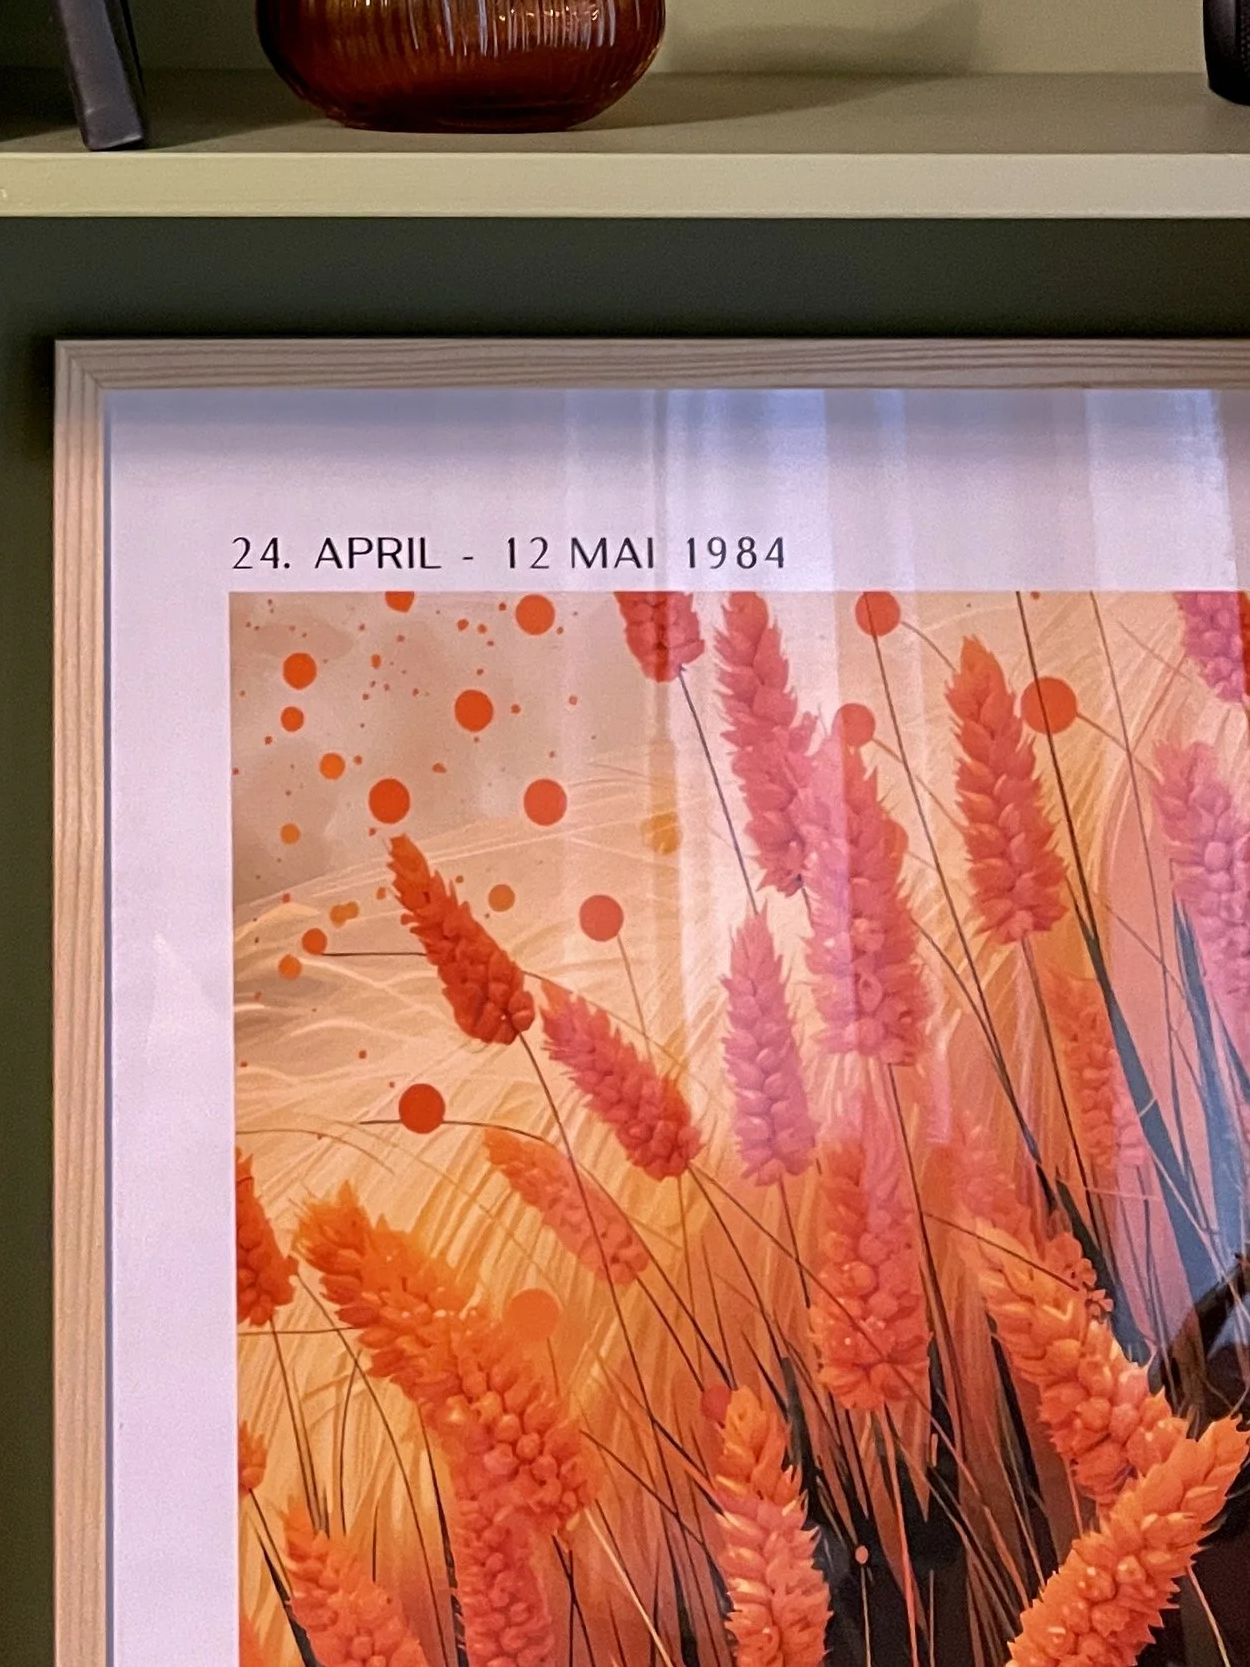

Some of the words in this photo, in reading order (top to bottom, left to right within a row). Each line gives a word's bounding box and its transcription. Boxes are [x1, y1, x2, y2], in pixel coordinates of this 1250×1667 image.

[231, 535, 291, 569] 24.
[313, 536, 442, 569] APRIL
[507, 536, 551, 570] 12
[570, 536, 654, 569] MAI
[686, 535, 786, 570] 1984
